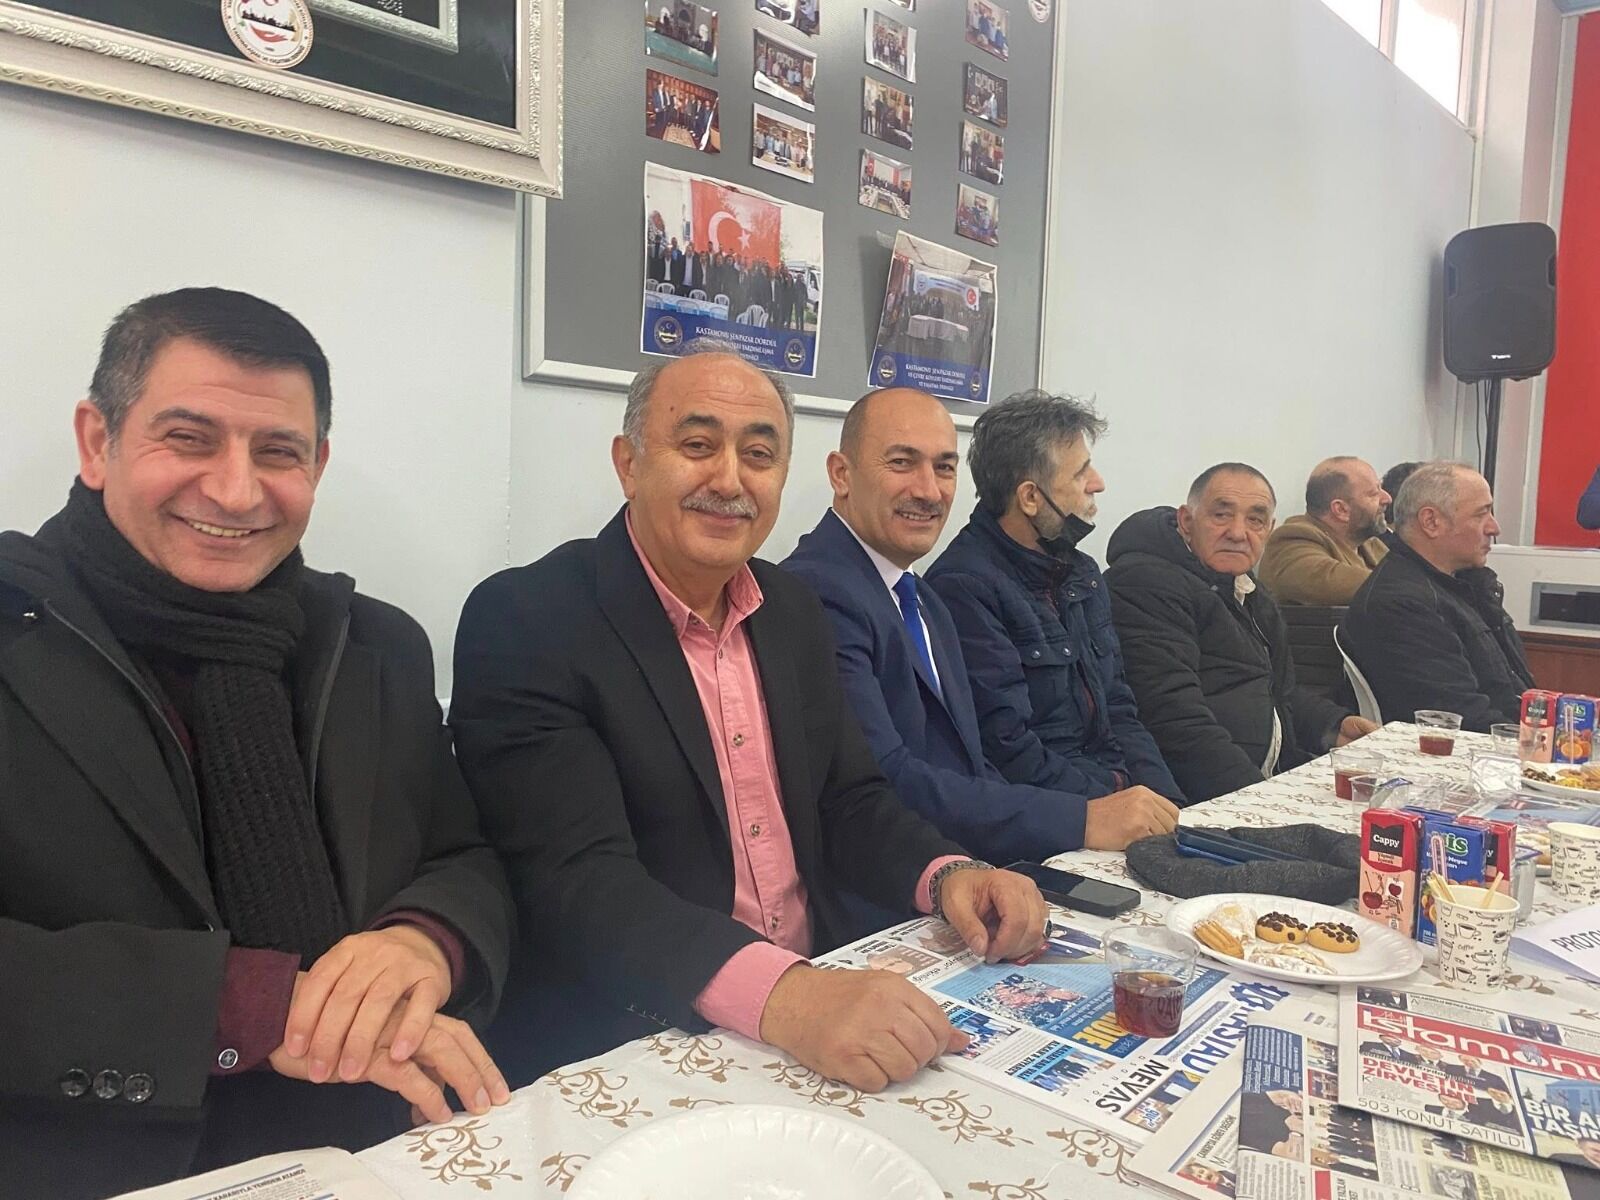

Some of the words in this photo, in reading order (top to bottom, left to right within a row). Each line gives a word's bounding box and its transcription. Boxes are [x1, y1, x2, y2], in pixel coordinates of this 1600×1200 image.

[1372, 834, 1400, 848] Cappy
[1095, 1059, 1170, 1114] MEVAS
[1358, 1097, 1390, 1113] 503
[1396, 1106, 1455, 1130] KONUT
[1460, 1122, 1527, 1150] SATILDI
[1523, 1097, 1573, 1123] BİR
